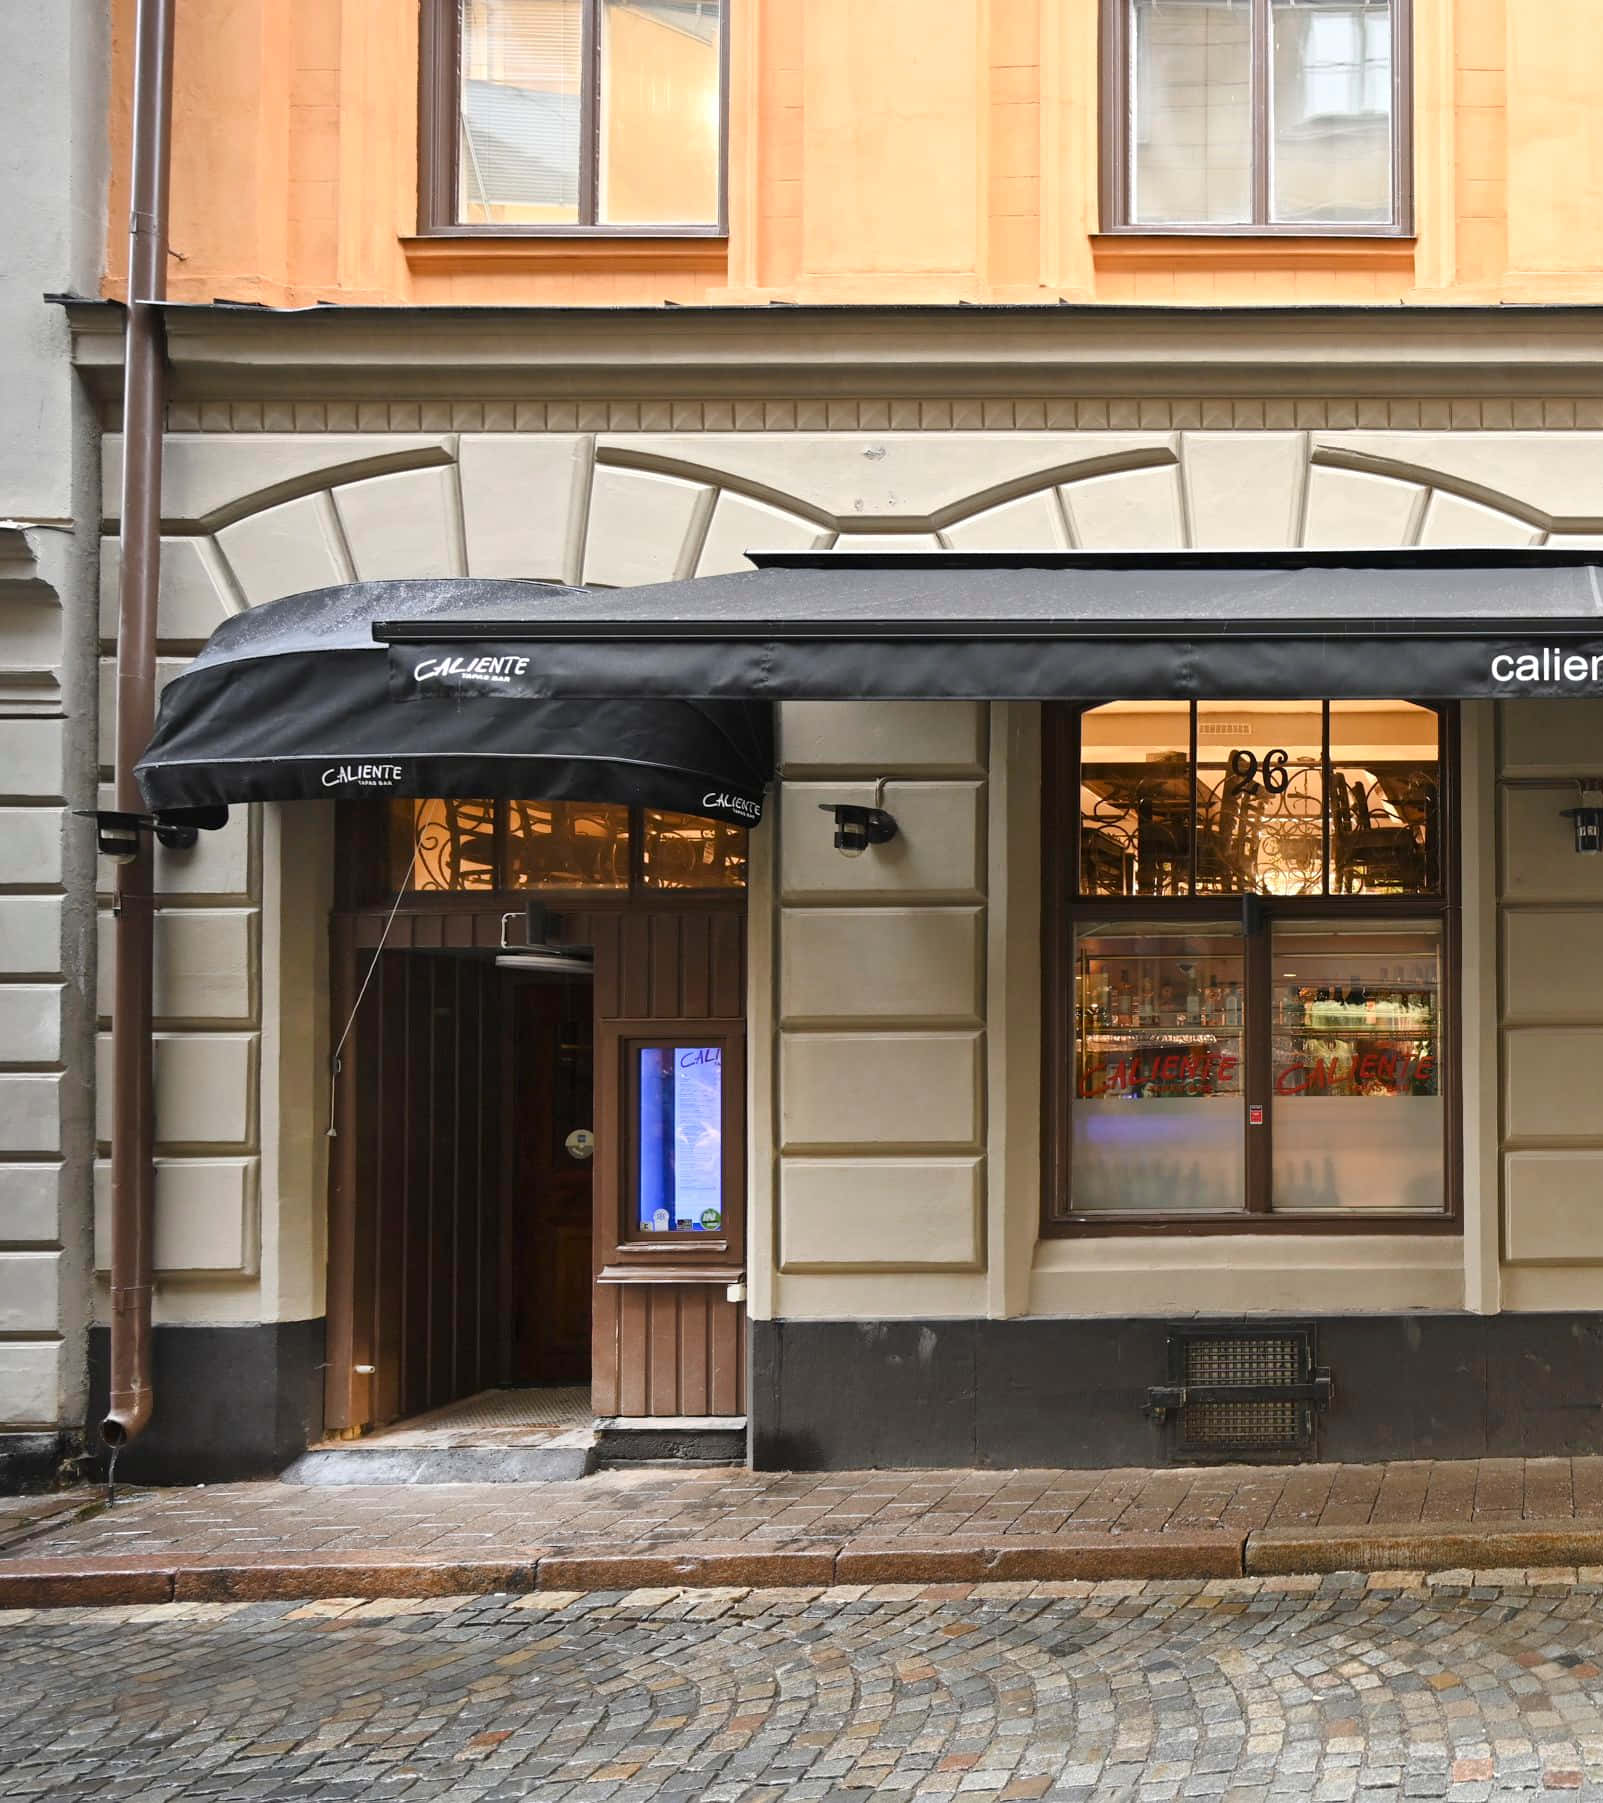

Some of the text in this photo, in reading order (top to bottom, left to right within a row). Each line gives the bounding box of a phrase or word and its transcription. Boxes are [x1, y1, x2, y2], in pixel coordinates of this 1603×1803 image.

[414, 656, 530, 681] CALIENTE
[321, 764, 402, 786] CALIENTE
[1232, 749, 1288, 797] 26
[702, 792, 761, 816] CALIENTE
[680, 1048, 721, 1068] CALI
[1080, 1054, 1237, 1097] CALIENTE
[1276, 1053, 1434, 1096] CALIENTE
